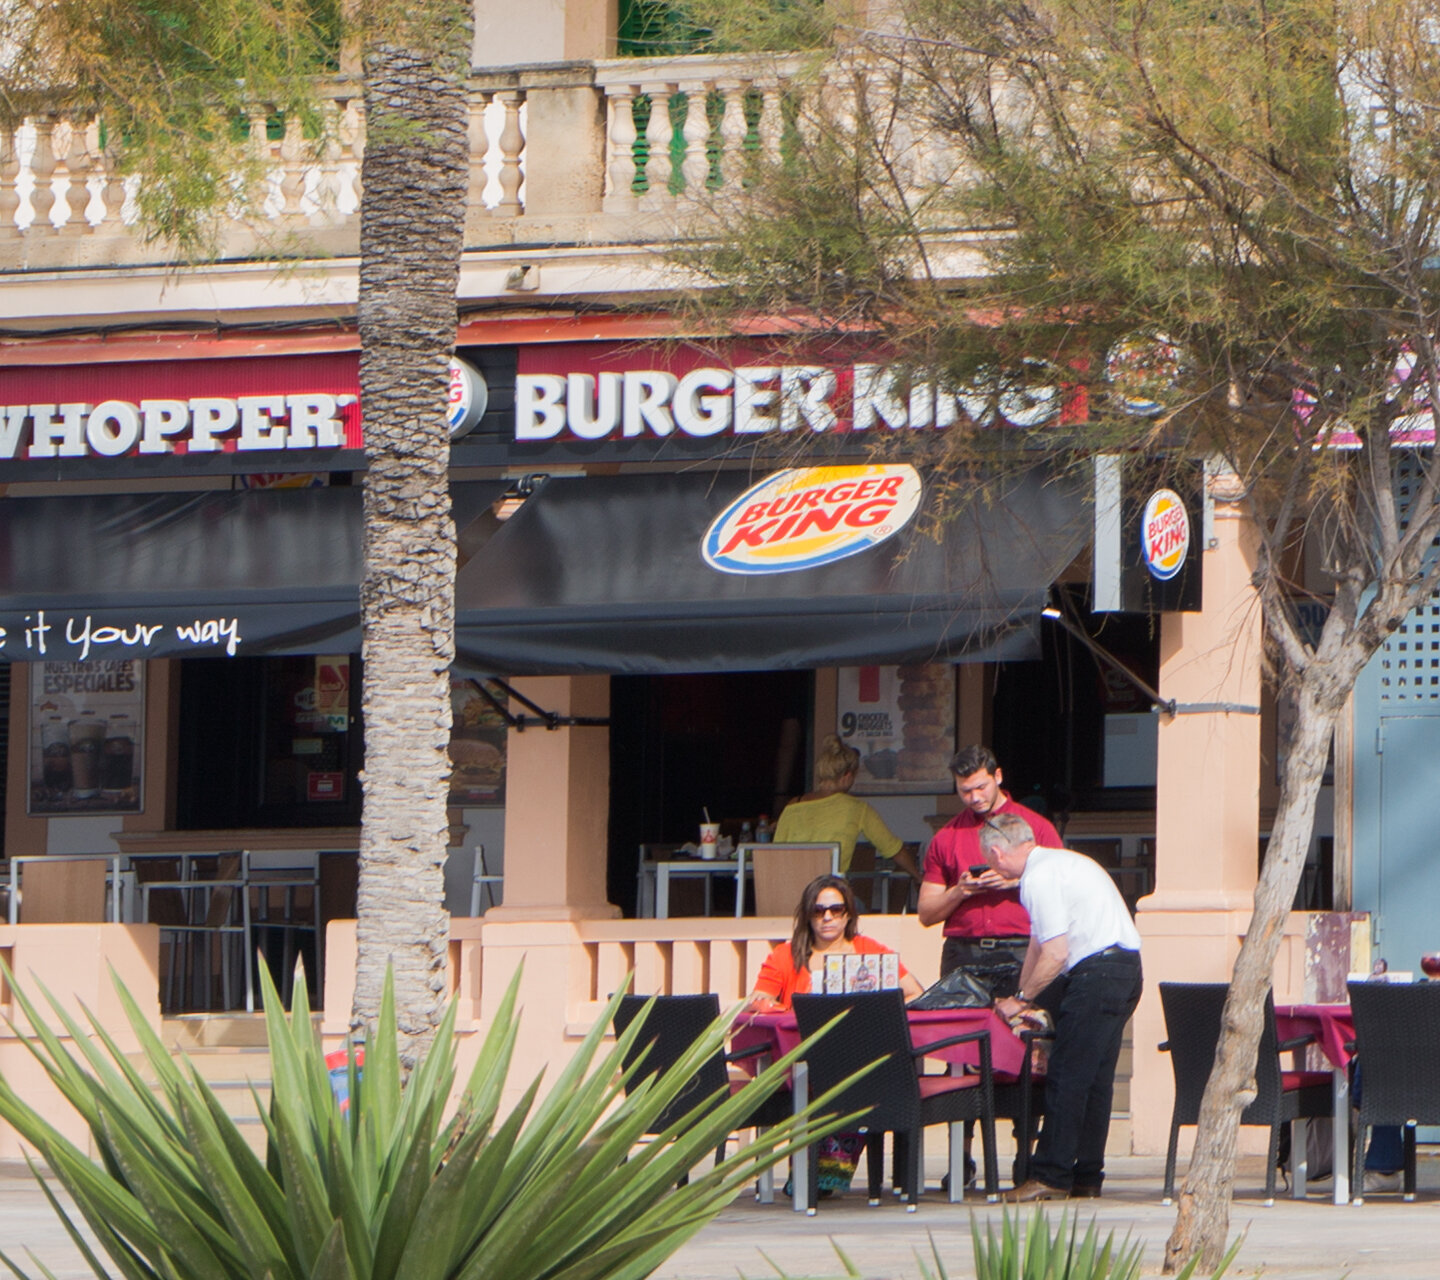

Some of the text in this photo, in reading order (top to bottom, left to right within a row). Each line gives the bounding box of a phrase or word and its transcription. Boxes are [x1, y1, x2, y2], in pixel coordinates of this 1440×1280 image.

[515, 363, 839, 440] BURGER
[852, 356, 1063, 431] KING
[734, 476, 905, 528] BURGER
[1148, 504, 1184, 540] BURGER
[717, 498, 899, 556] KING
[1148, 520, 1187, 563] KING
[25, 610, 52, 655] it
[43, 673, 135, 693] ESPECIALES
[841, 711, 857, 738] 9
